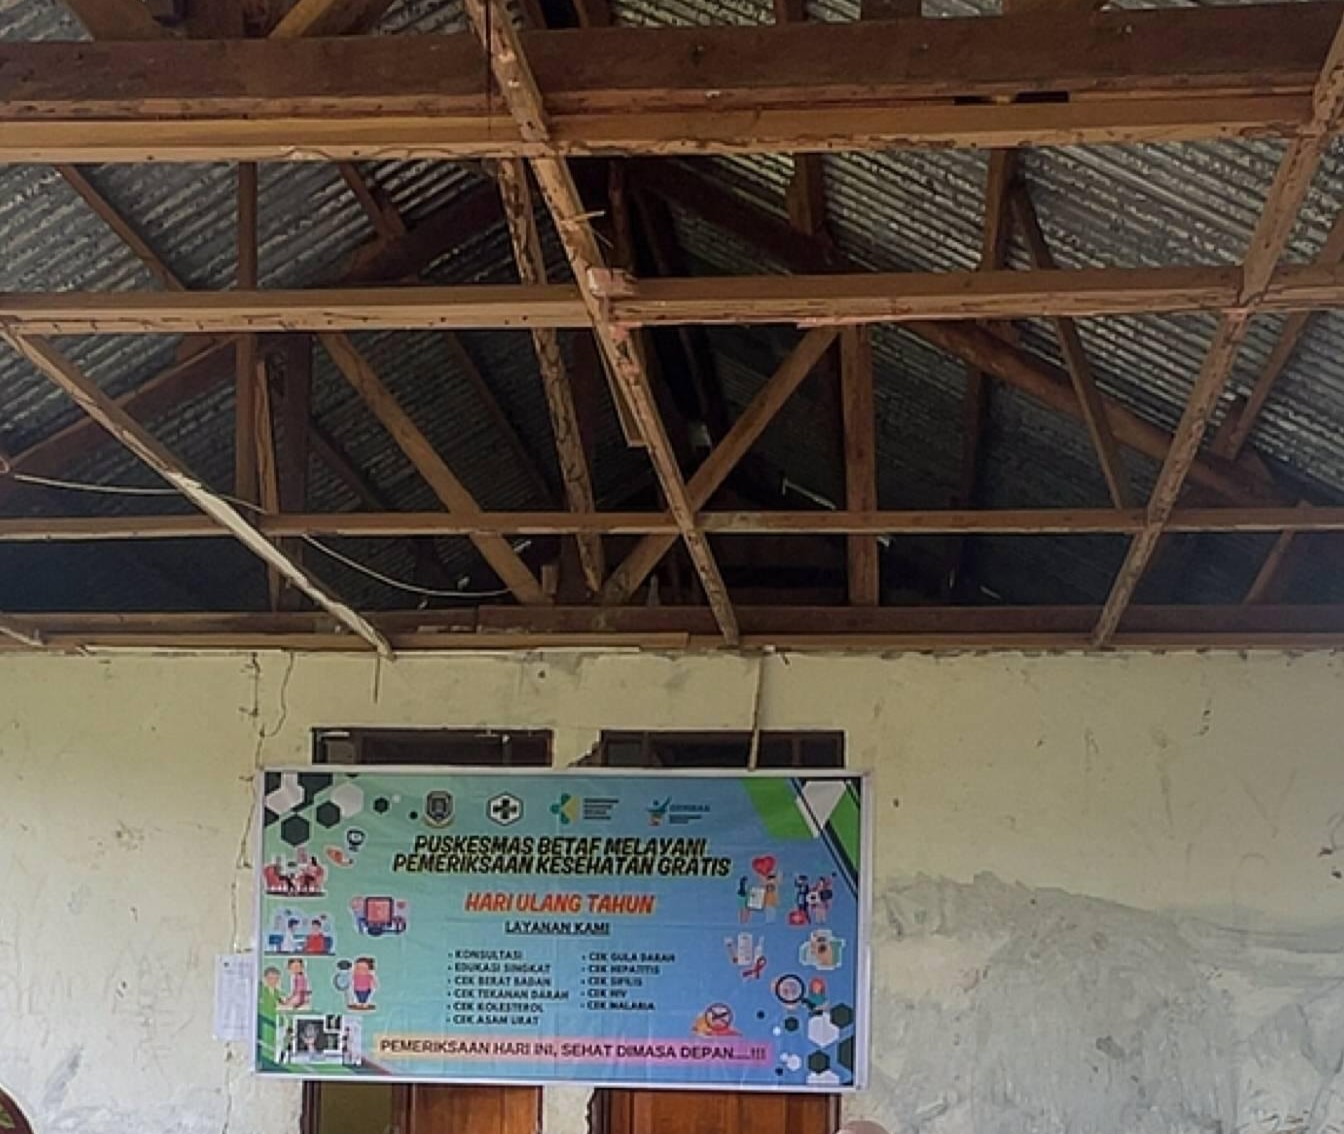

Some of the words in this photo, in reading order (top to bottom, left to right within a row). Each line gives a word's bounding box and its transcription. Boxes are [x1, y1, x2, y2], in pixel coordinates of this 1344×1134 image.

[414, 835, 534, 855] PUSKESMAS
[538, 836, 601, 856] BETAF
[604, 837, 707, 856] MELAYANI
[393, 854, 533, 874] PEMERIKSAAN
[536, 856, 655, 875] KESEHATAN
[657, 857, 732, 876] GRATIS
[464, 892, 514, 912] HARI
[515, 893, 583, 912] ULANG
[586, 894, 656, 914] TAHUN
[505, 921, 570, 935] LAYANAN
[572, 922, 610, 935] KAMI
[380, 1039, 490, 1054] PEMERIKSAAN
[492, 1042, 531, 1055] HARI
[561, 1043, 614, 1057] SEHAT
[617, 1044, 677, 1058] DIMASA
